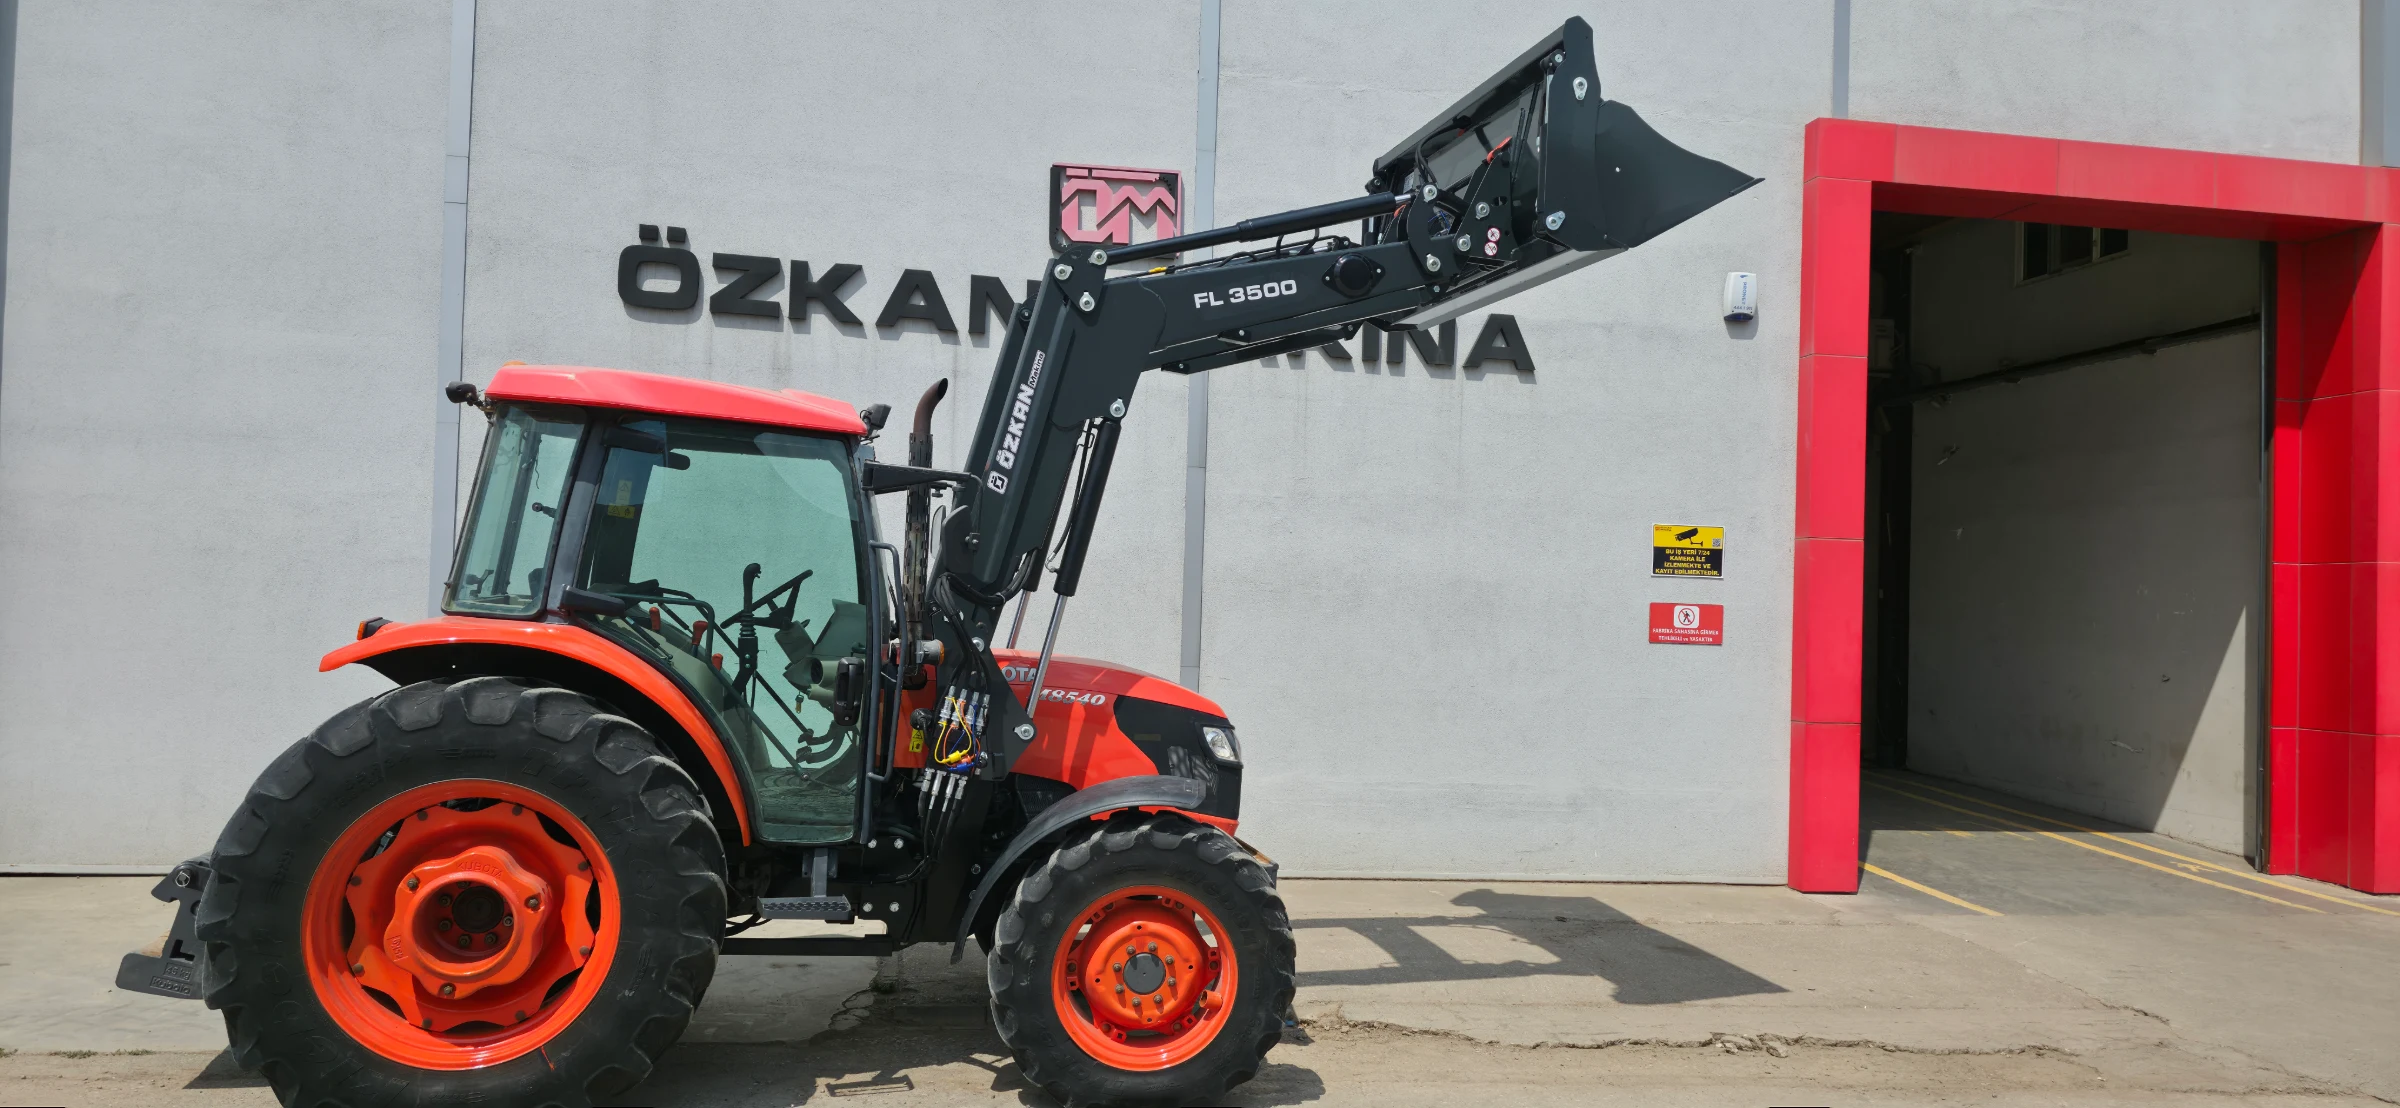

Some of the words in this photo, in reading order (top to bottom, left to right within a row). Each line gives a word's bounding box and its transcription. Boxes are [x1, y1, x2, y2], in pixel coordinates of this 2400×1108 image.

[617, 223, 1043, 334] ÖZKAN
[1193, 291, 1225, 309] FL
[1228, 279, 1298, 304] 3500
[995, 382, 1035, 470] ÖZKAN
[1028, 351, 1045, 388] Makina
[457, 861, 502, 879] KUBOTA
